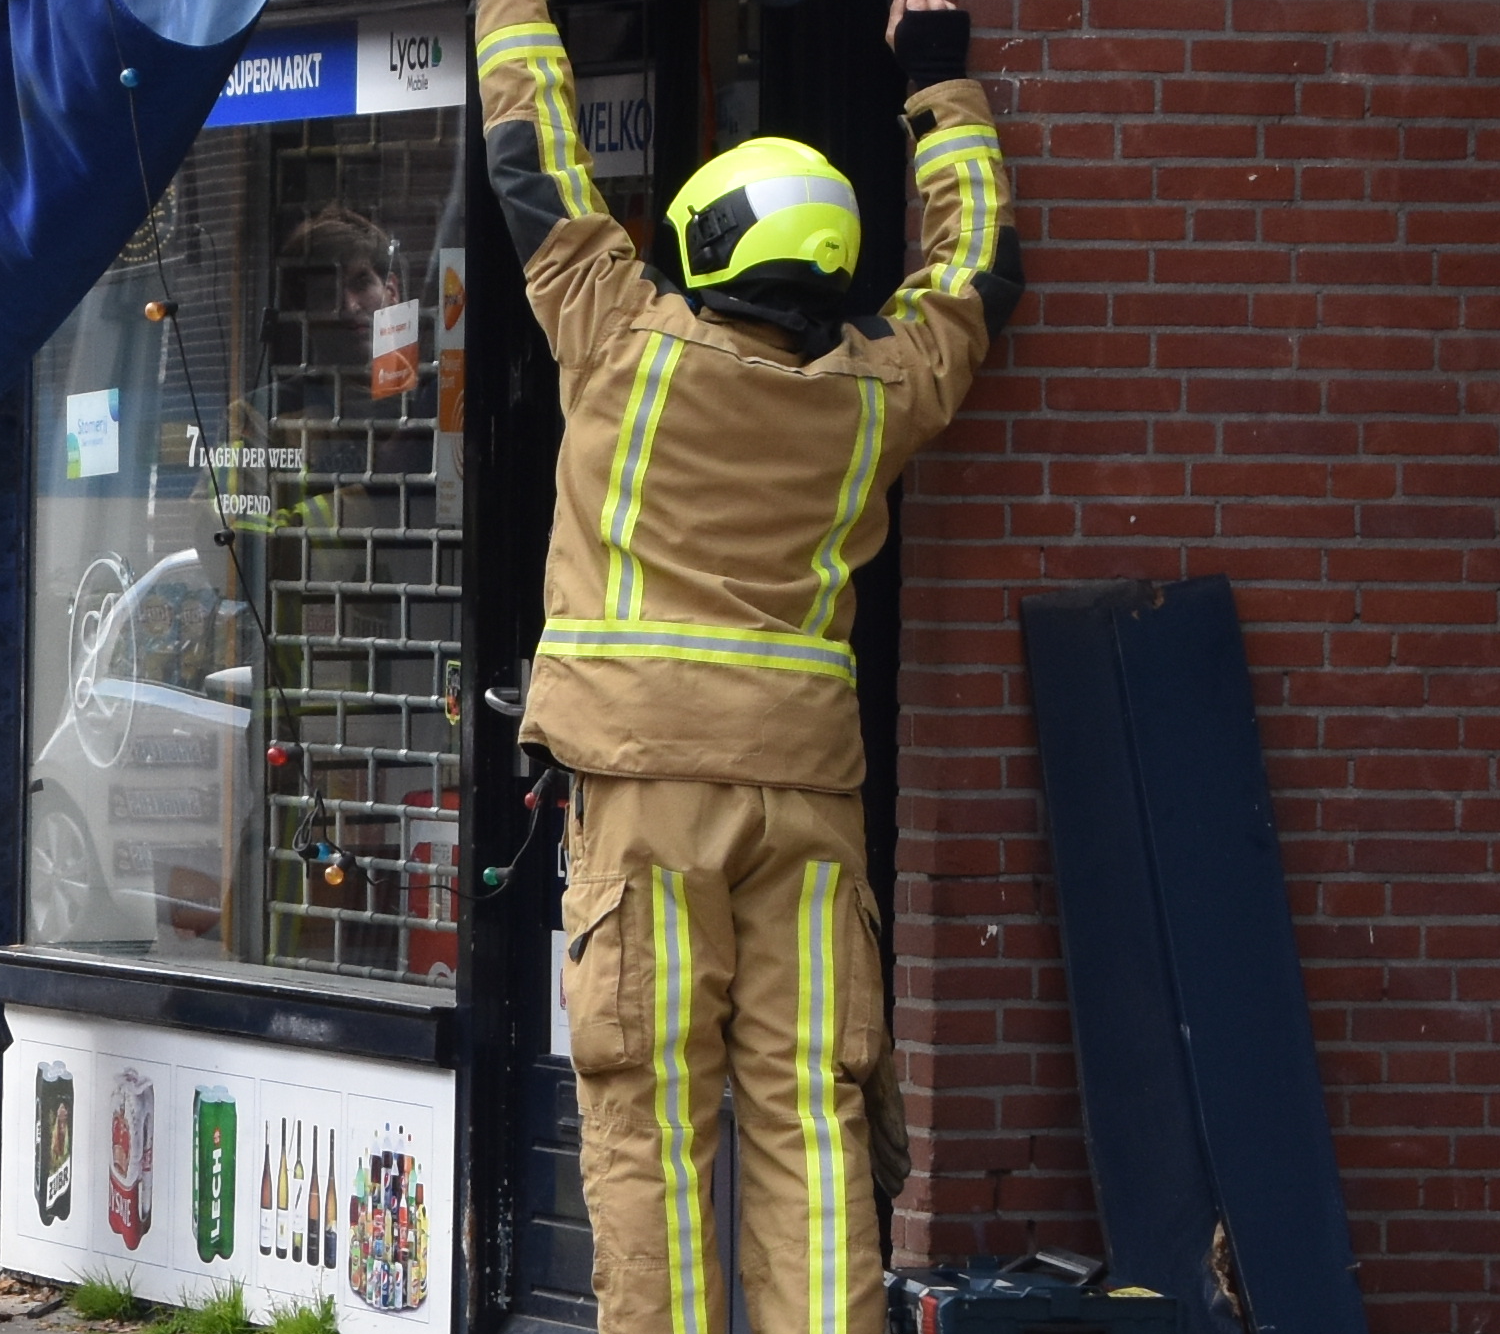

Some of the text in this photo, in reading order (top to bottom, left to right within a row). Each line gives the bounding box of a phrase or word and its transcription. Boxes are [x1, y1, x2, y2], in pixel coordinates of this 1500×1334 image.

[226, 52, 323, 97] SUPERMARKT
[389, 31, 429, 80] Lyca
[406, 75, 429, 92] Mobile
[186, 424, 304, 468] 7 DAGEN PER WEEK
[214, 494, 271, 516] GEOPEND
[210, 1148, 222, 1239] LECH
